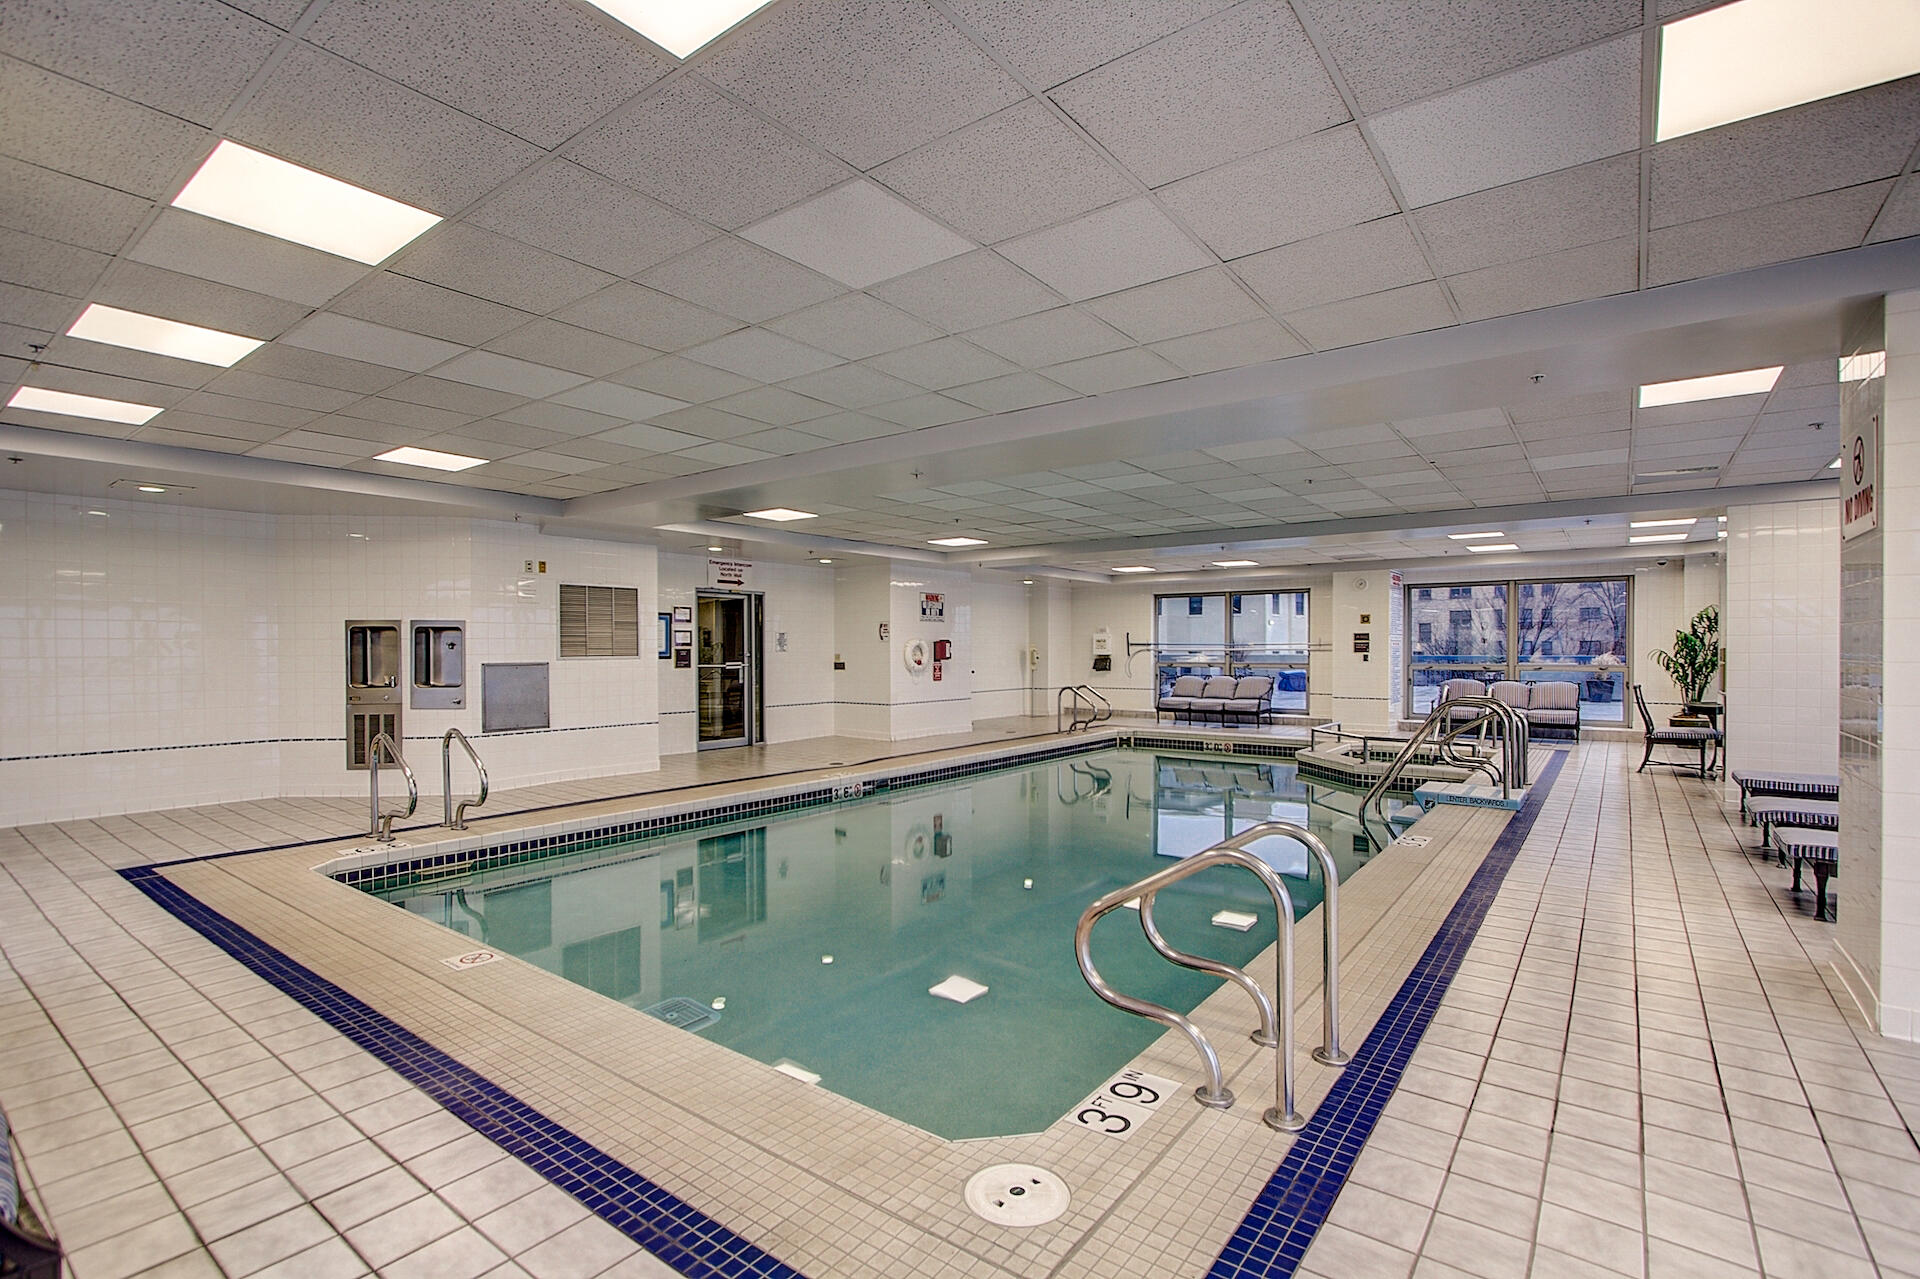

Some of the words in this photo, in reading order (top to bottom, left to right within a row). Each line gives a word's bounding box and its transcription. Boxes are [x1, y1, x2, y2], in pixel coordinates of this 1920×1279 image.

[1845, 497, 1853, 525] NO
[1854, 484, 1873, 521] DIVING
[709, 559, 733, 567] Emergency
[834, 788, 839, 800] 3
[1449, 795, 1468, 803] ENTER
[1469, 796, 1505, 807] BACKWARDS
[1122, 1069, 1144, 1082] IN
[1109, 1082, 1160, 1104] 9
[1091, 1095, 1113, 1109] FT
[1077, 1108, 1131, 1133] 3
